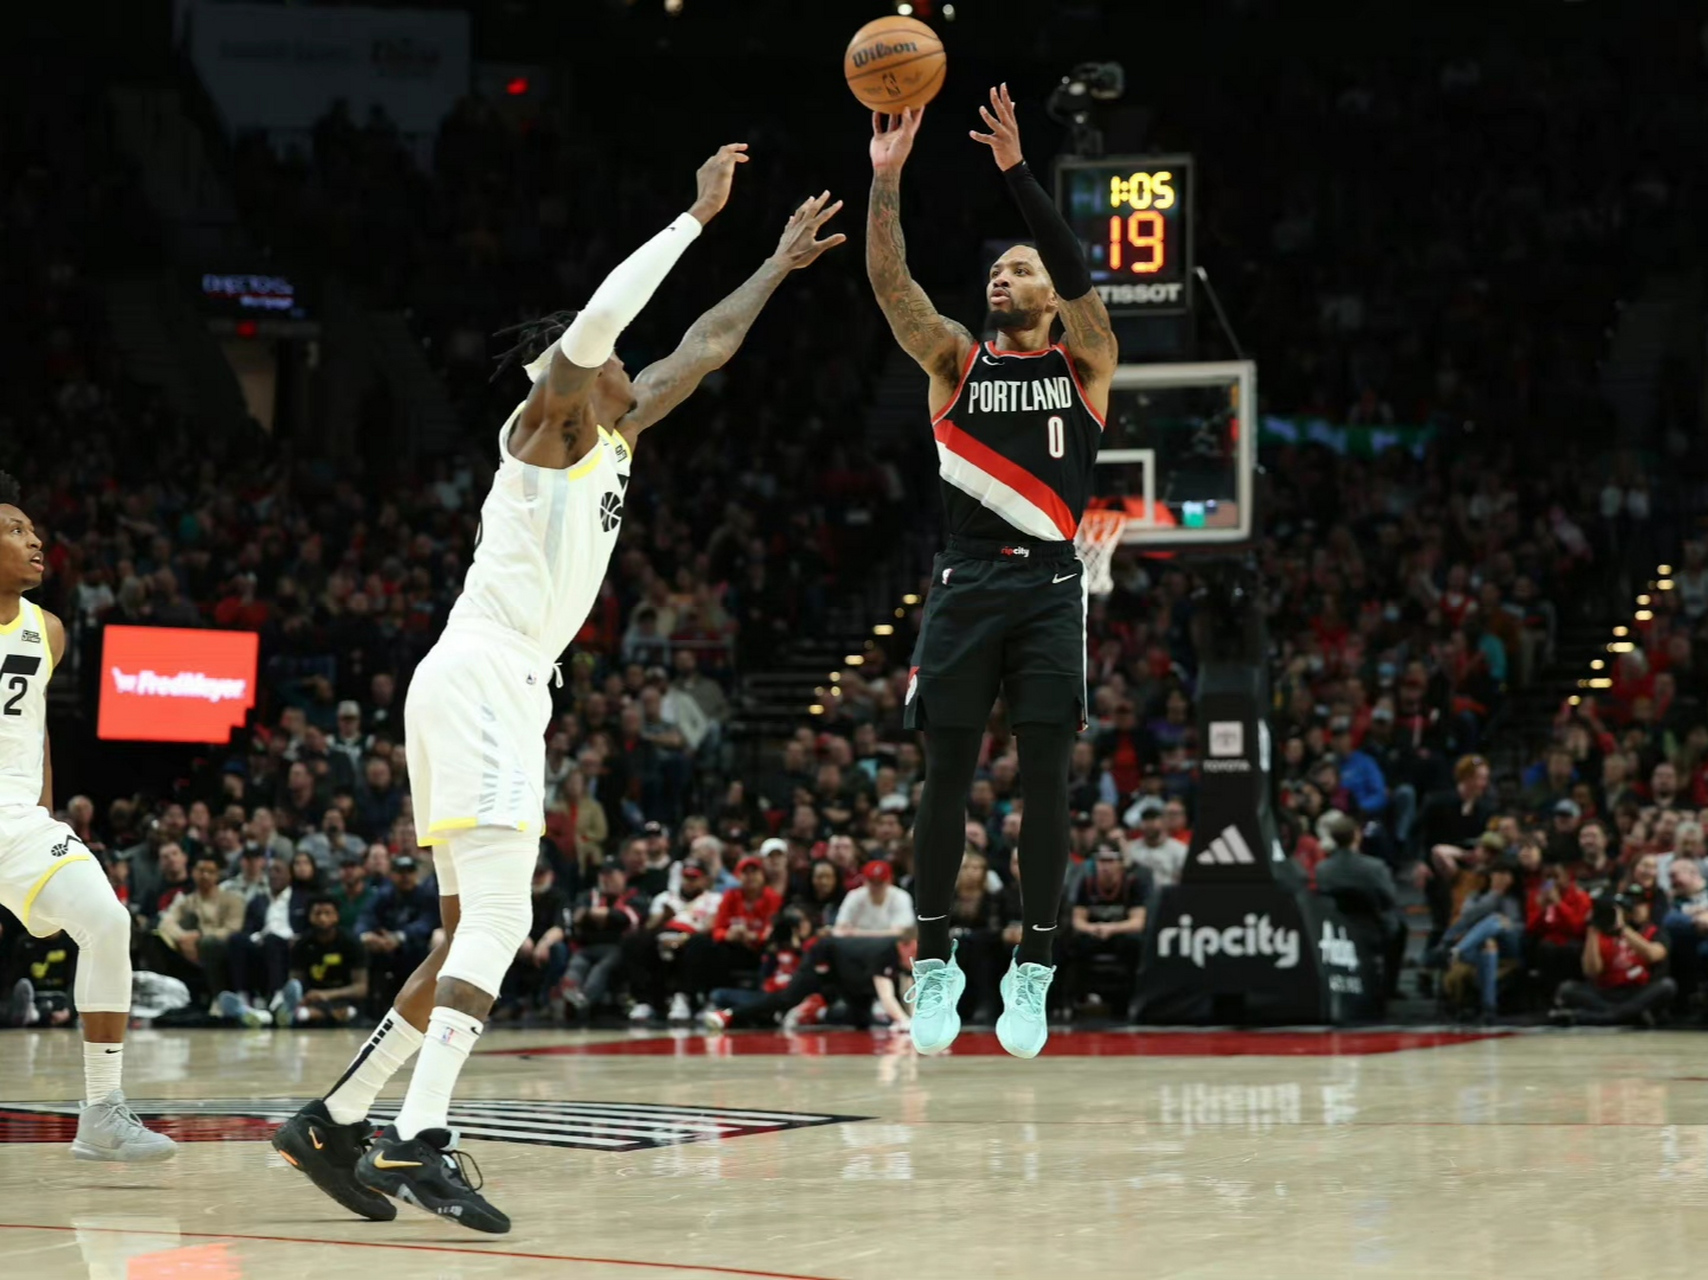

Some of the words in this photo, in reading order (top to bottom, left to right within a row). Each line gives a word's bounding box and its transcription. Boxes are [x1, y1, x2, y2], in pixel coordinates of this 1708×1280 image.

[852, 42, 917, 68] Wilson
[1110, 170, 1175, 210] 1:05
[1109, 210, 1165, 274] 19
[1098, 282, 1182, 304] TISSOT
[968, 376, 1072, 414] PORTLAND
[1048, 416, 1065, 459] 0
[1001, 546, 1030, 558] ripcity
[3, 676, 28, 716] 2
[1202, 758, 1252, 773] TOYOTA
[1157, 912, 1300, 969] ripcity
